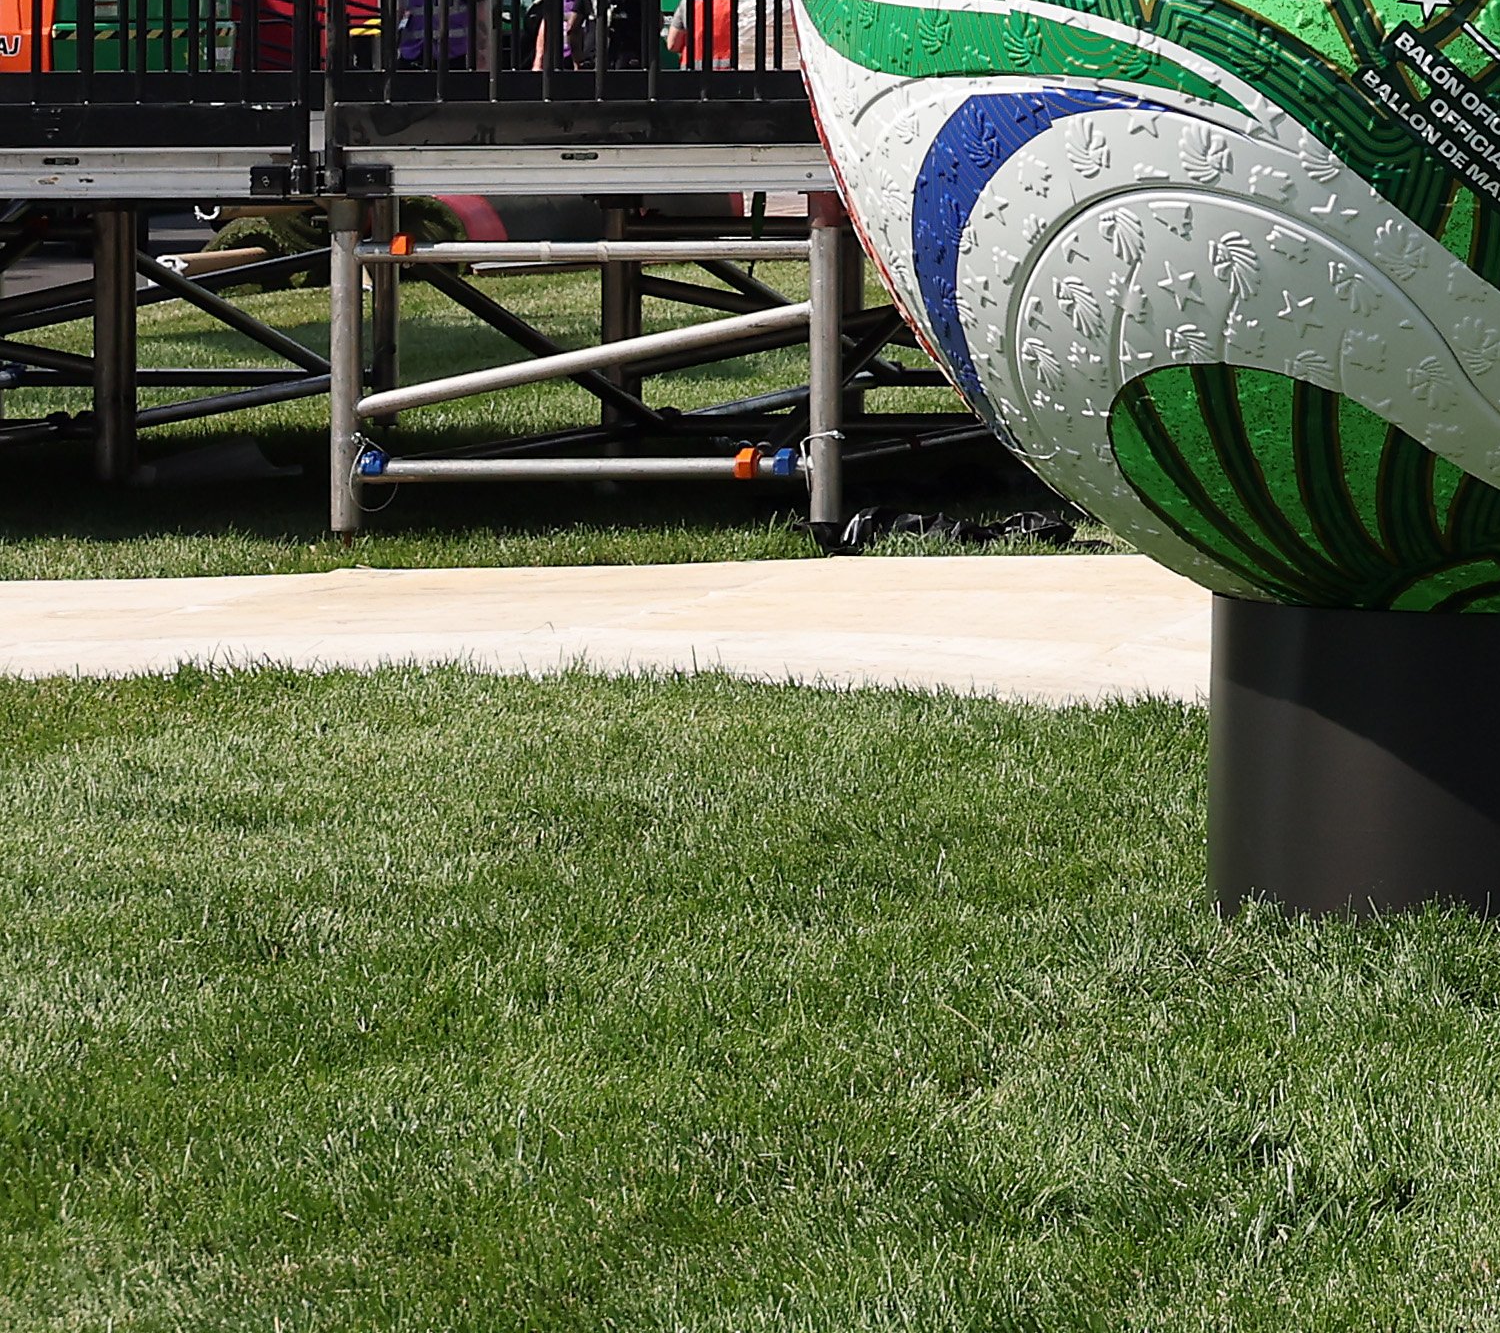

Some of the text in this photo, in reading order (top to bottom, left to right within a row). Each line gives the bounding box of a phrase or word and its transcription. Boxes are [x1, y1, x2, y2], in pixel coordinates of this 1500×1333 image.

[1394, 31, 1463, 98] BALÓN
[1362, 69, 1443, 145] BALLON
[1438, 141, 1469, 170] DE
